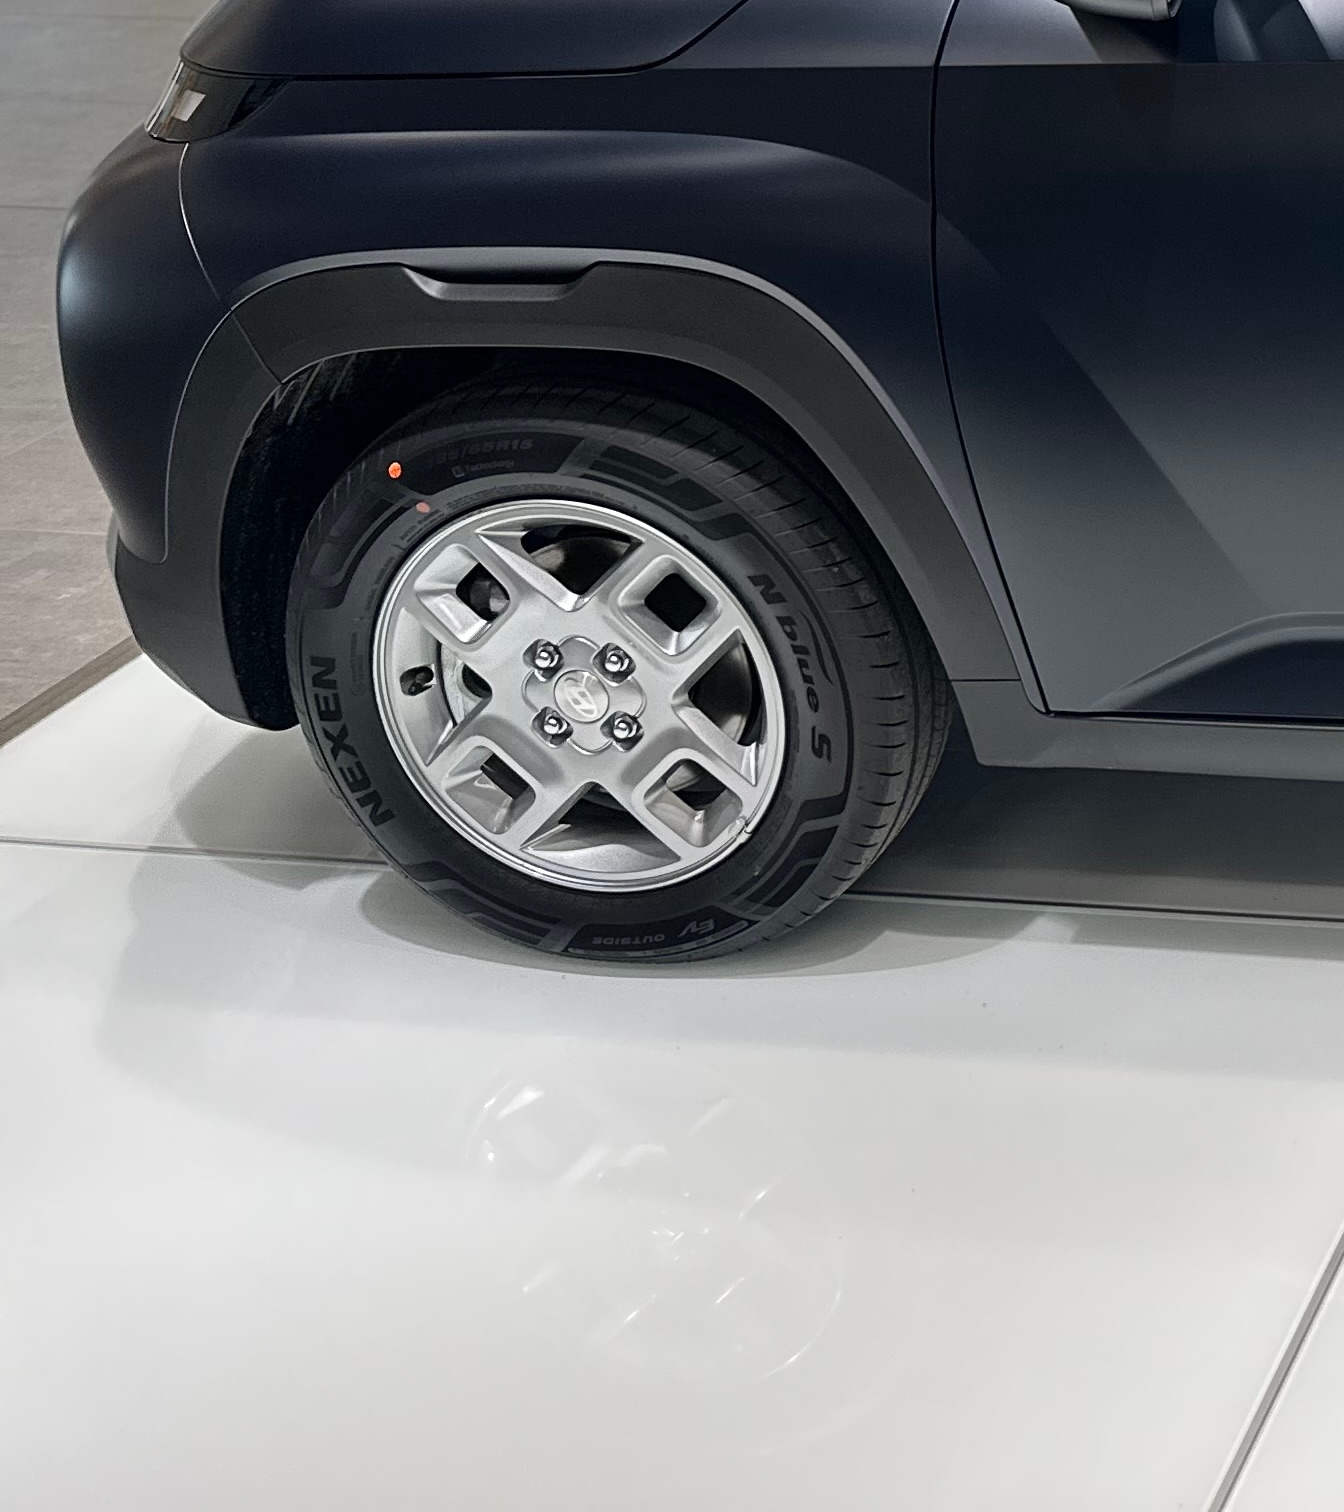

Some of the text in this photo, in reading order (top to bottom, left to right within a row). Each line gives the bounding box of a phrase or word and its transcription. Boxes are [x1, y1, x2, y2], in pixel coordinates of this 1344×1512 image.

[308, 656, 394, 827] NEXEN
[747, 573, 833, 764] N blue S
[591, 933, 666, 945] OUTSIDE
